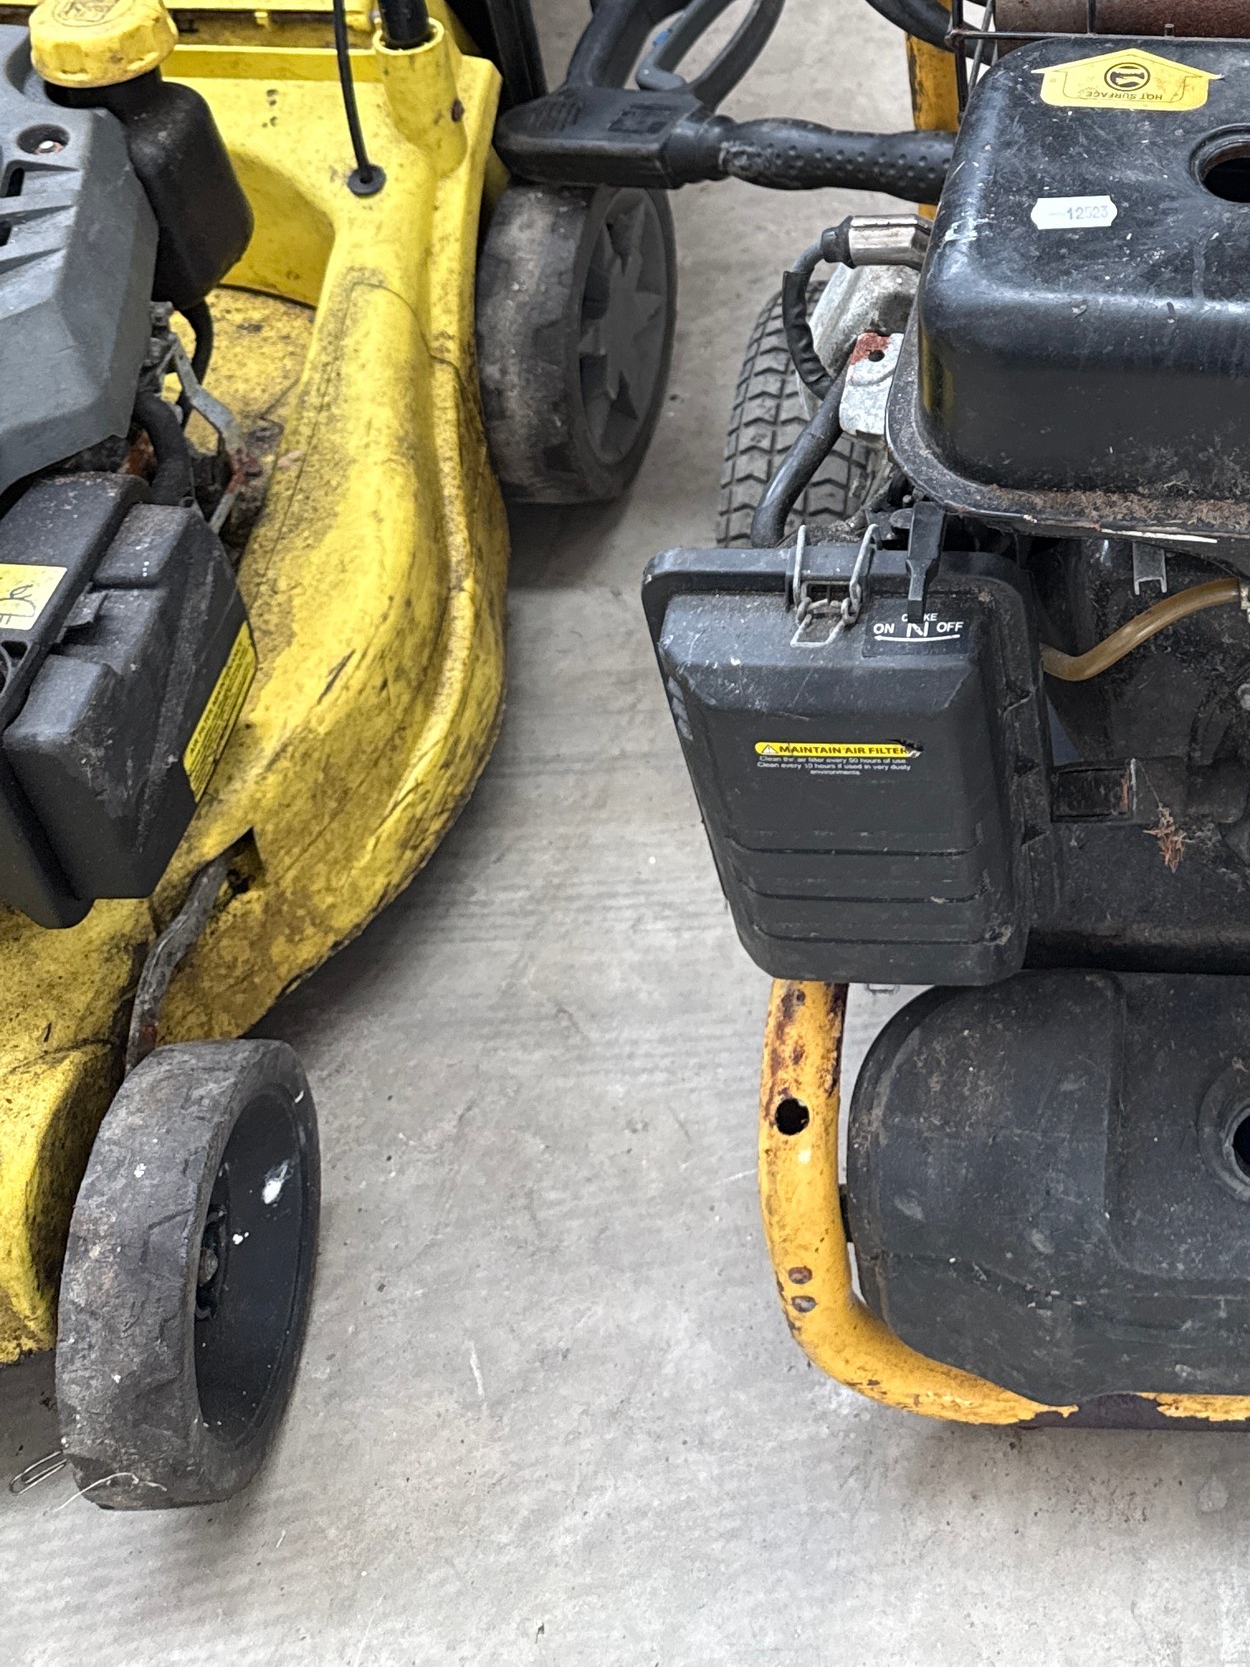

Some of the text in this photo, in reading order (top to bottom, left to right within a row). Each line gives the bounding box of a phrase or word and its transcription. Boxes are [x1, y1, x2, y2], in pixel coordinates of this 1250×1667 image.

[1087, 91, 1163, 101] HOT SURFACE
[1066, 205, 1109, 220] 12523
[901, 613, 938, 622] CKE
[873, 621, 964, 635] ON OFF
[779, 745, 908, 755] MAINTAIN AIR FILTER
[890, 764, 911, 772] dusty
